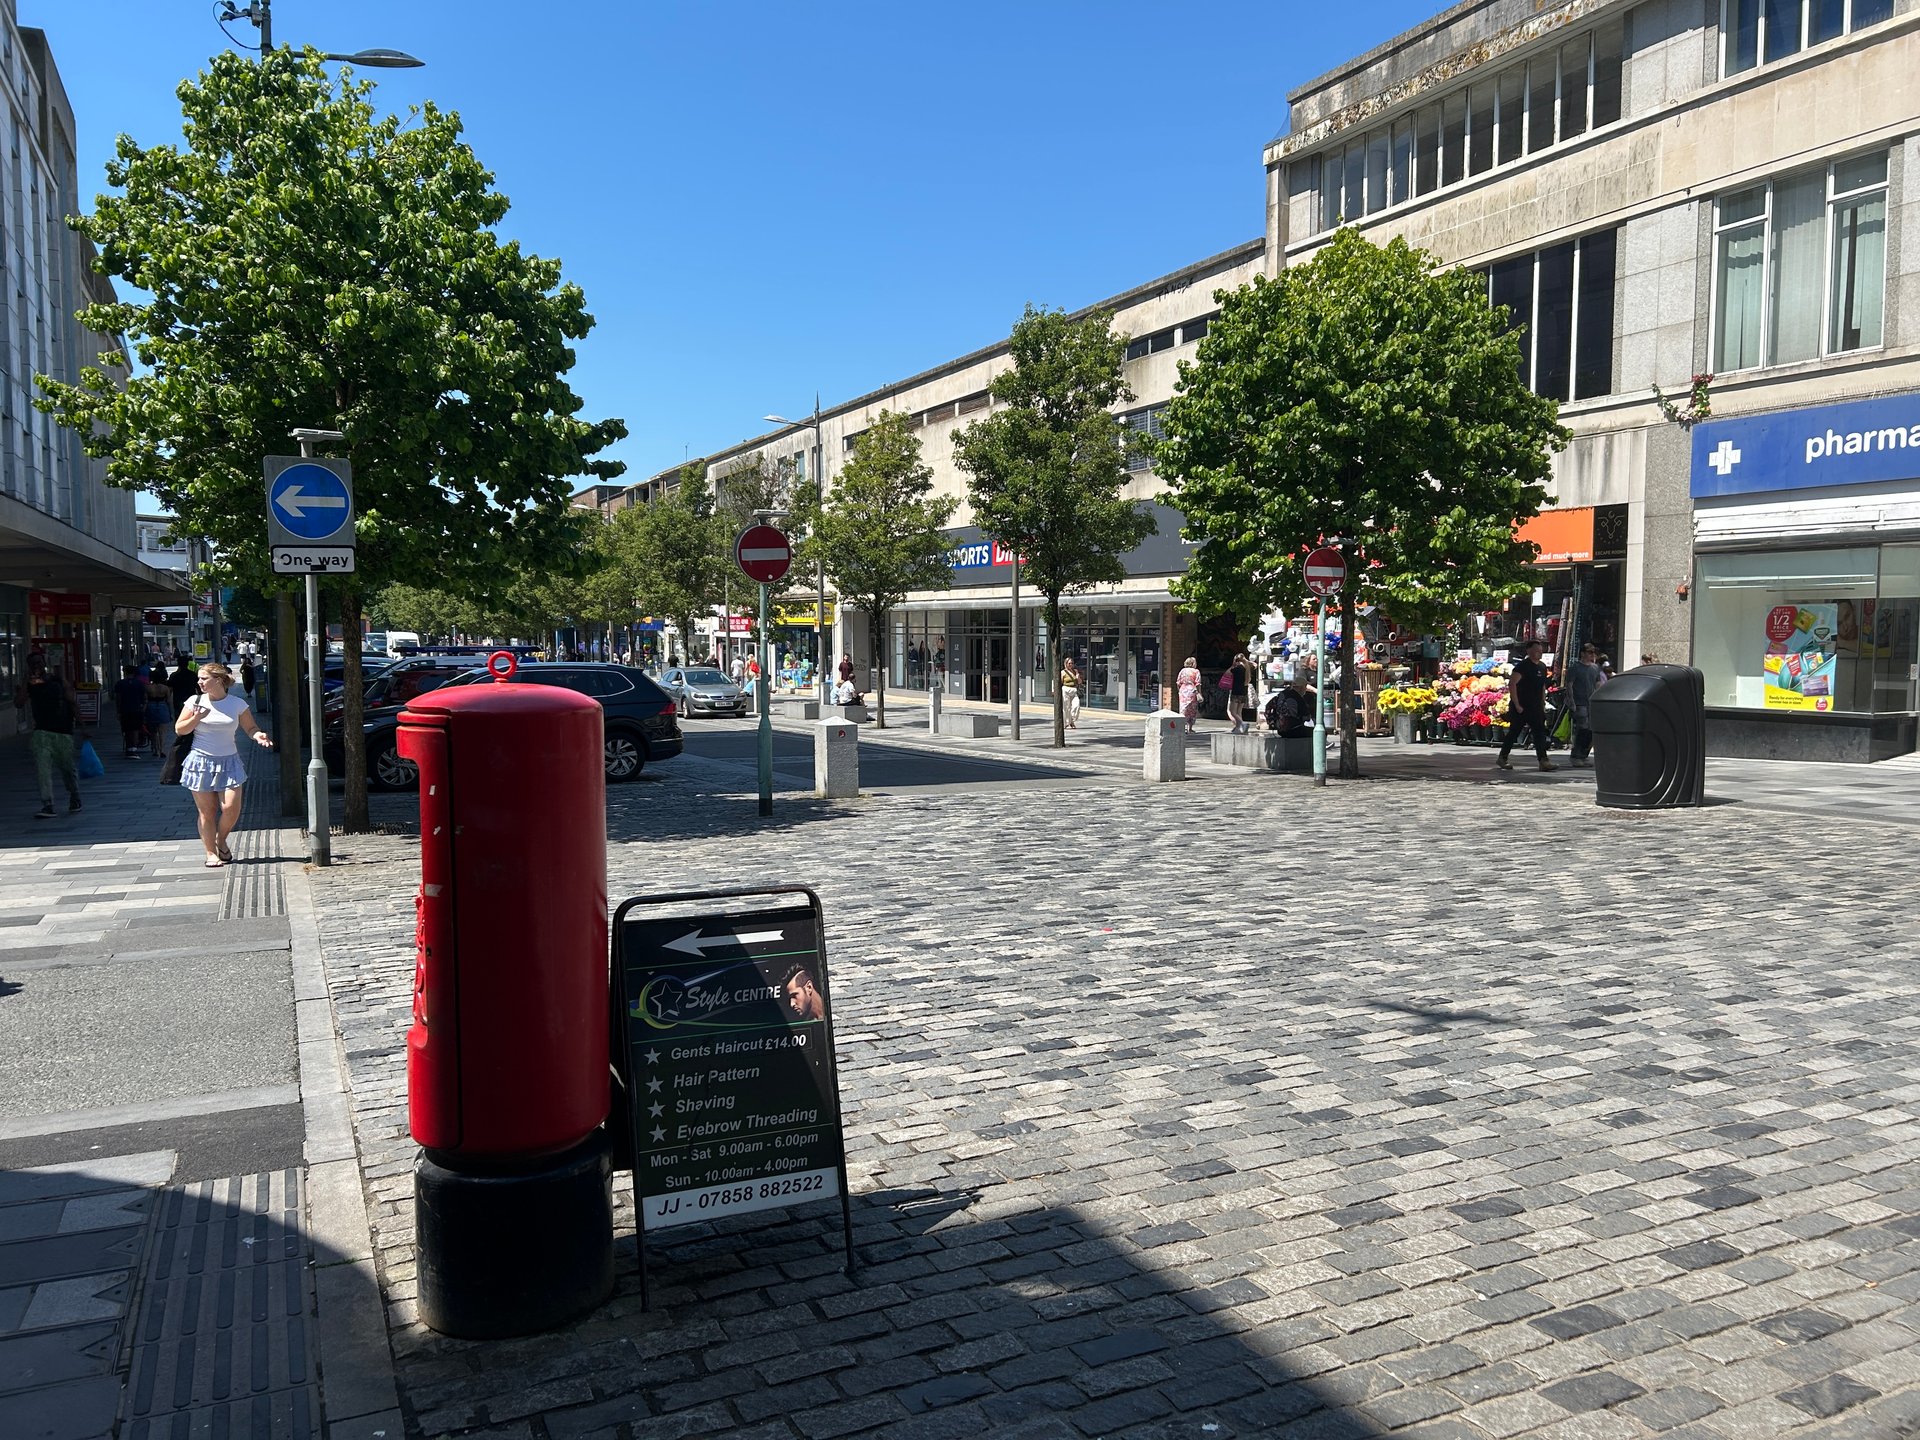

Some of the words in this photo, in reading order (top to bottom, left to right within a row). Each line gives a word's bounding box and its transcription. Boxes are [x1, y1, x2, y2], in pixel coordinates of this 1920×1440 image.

[1805, 424, 1920, 464] pharma
[280, 553, 312, 566] One
[318, 556, 349, 568] way
[946, 545, 990, 568] SPORTS
[1552, 551, 1572, 560] much
[1572, 550, 1589, 558] more
[1773, 614, 1790, 626] 1/2
[685, 986, 730, 1012] Style
[734, 985, 781, 1003] CENTRE
[671, 1045, 711, 1060] Gents
[715, 1039, 765, 1055] Haircut
[765, 1034, 807, 1050] £14.00
[673, 1073, 705, 1089] Hair
[708, 1066, 760, 1085] Pattern
[675, 1093, 736, 1114] Shaving
[677, 1119, 742, 1141] Eyebrow
[746, 1108, 818, 1129] Threading
[650, 1153, 679, 1168] Mon
[690, 1146, 712, 1161] Sat
[719, 1141, 763, 1157] 9.00am
[774, 1132, 819, 1149] 6.00pm
[665, 1174, 691, 1188] Sun
[704, 1165, 754, 1182] 10.00am
[764, 1156, 808, 1173] 4.00pm
[657, 1197, 681, 1216] JJ
[698, 1186, 753, 1209] 07858
[759, 1174, 823, 1198] 882522
